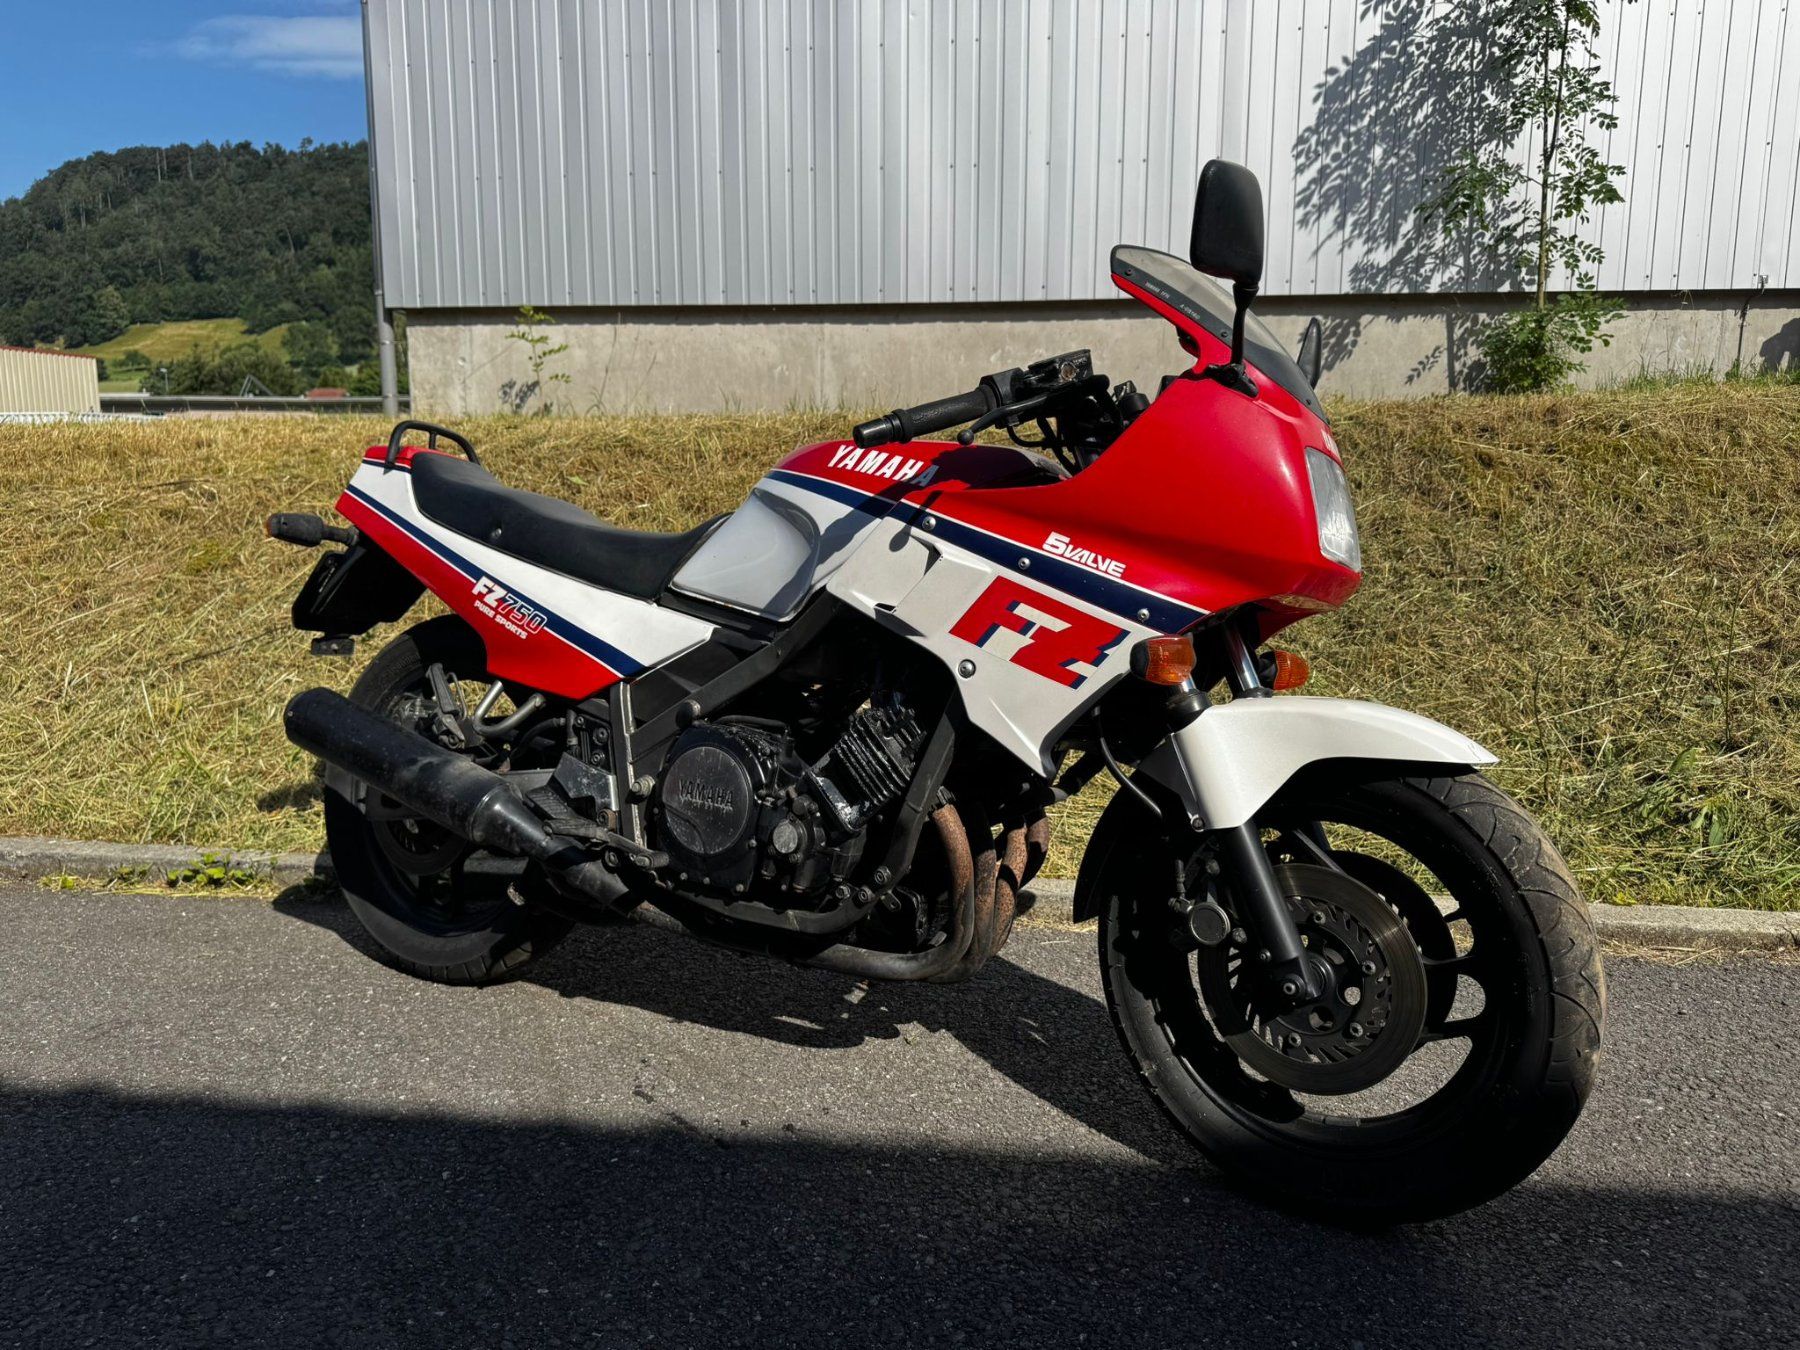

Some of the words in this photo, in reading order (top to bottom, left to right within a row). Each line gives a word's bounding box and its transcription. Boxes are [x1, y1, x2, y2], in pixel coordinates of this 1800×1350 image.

[827, 444, 940, 488] YAMAHA
[471, 575, 548, 635] FZ750
[473, 599, 496, 619] PURE
[494, 613, 529, 640] SPORTS
[679, 779, 734, 813] YAMAHA
